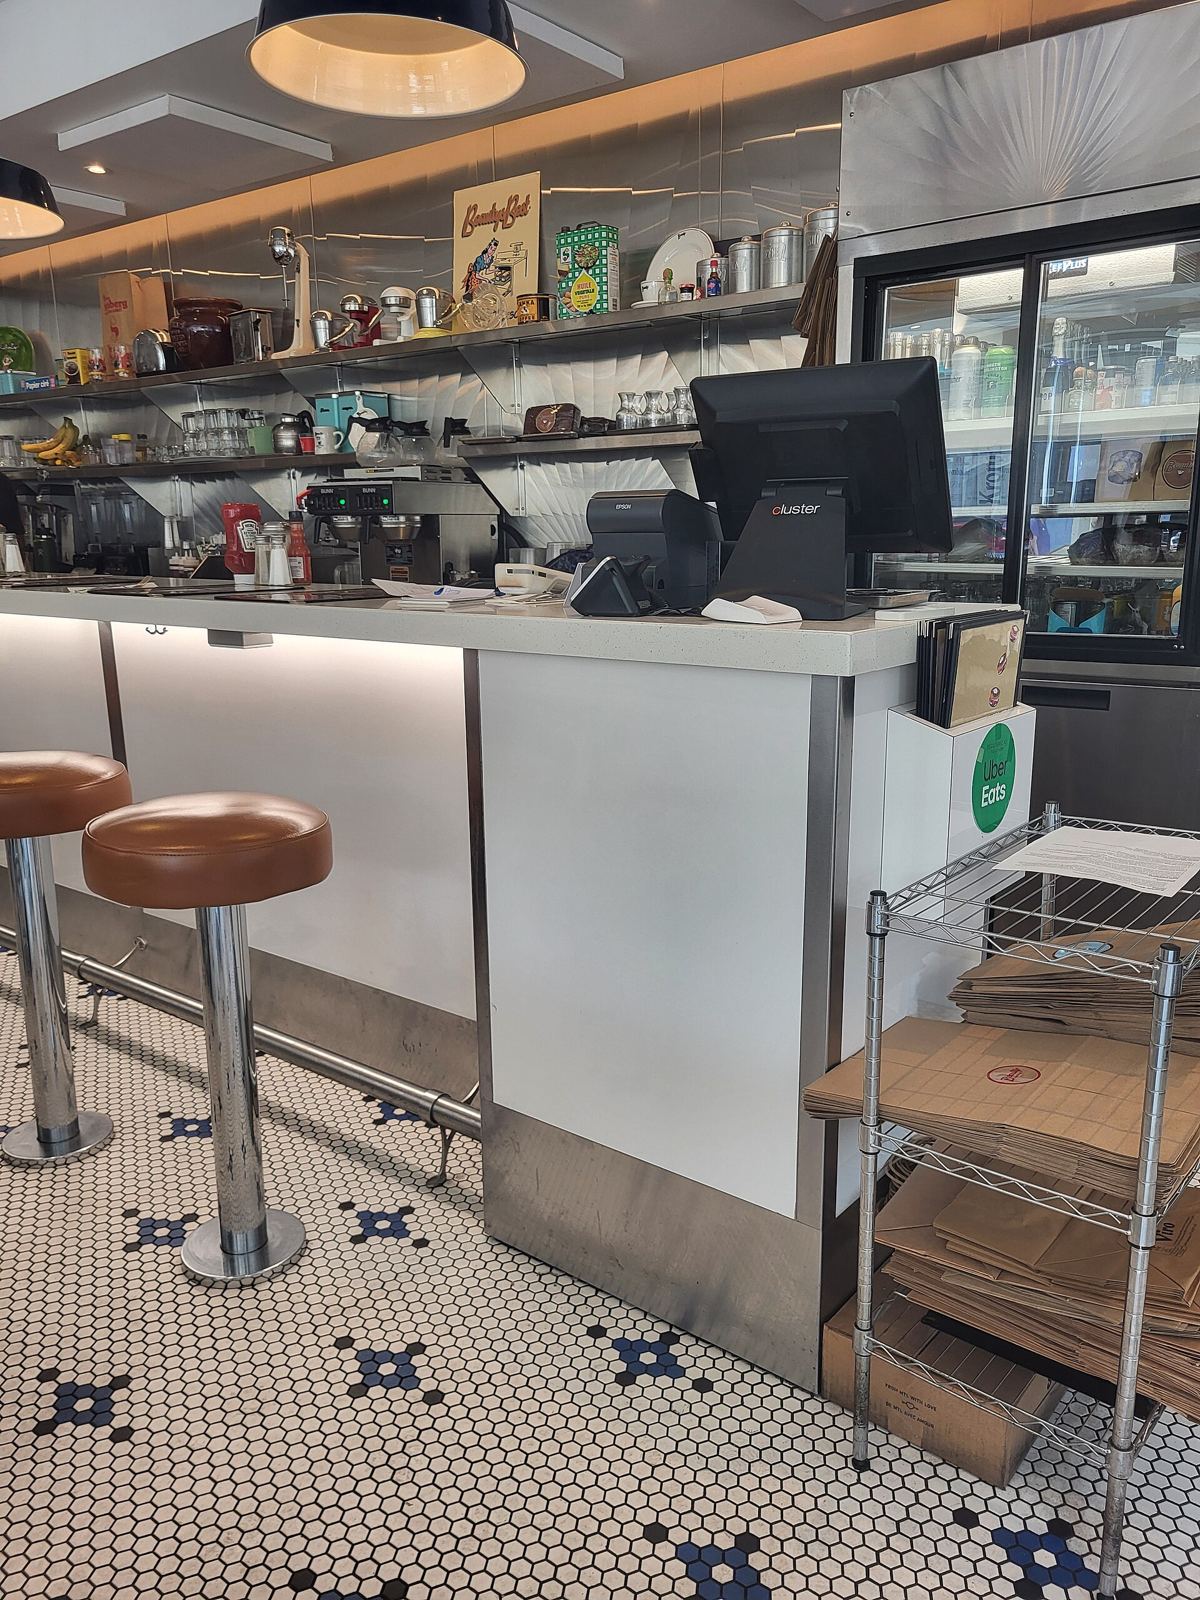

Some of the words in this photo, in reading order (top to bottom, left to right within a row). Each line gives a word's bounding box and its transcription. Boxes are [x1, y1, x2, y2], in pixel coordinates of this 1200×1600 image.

[25, 381, 40, 391] Papier
[772, 503, 820, 516] cluster
[983, 760, 1008, 782] Uber
[981, 782, 1006, 808] Eats
[910, 1396, 924, 1406] WITH
[924, 1402, 937, 1412] LOVE
